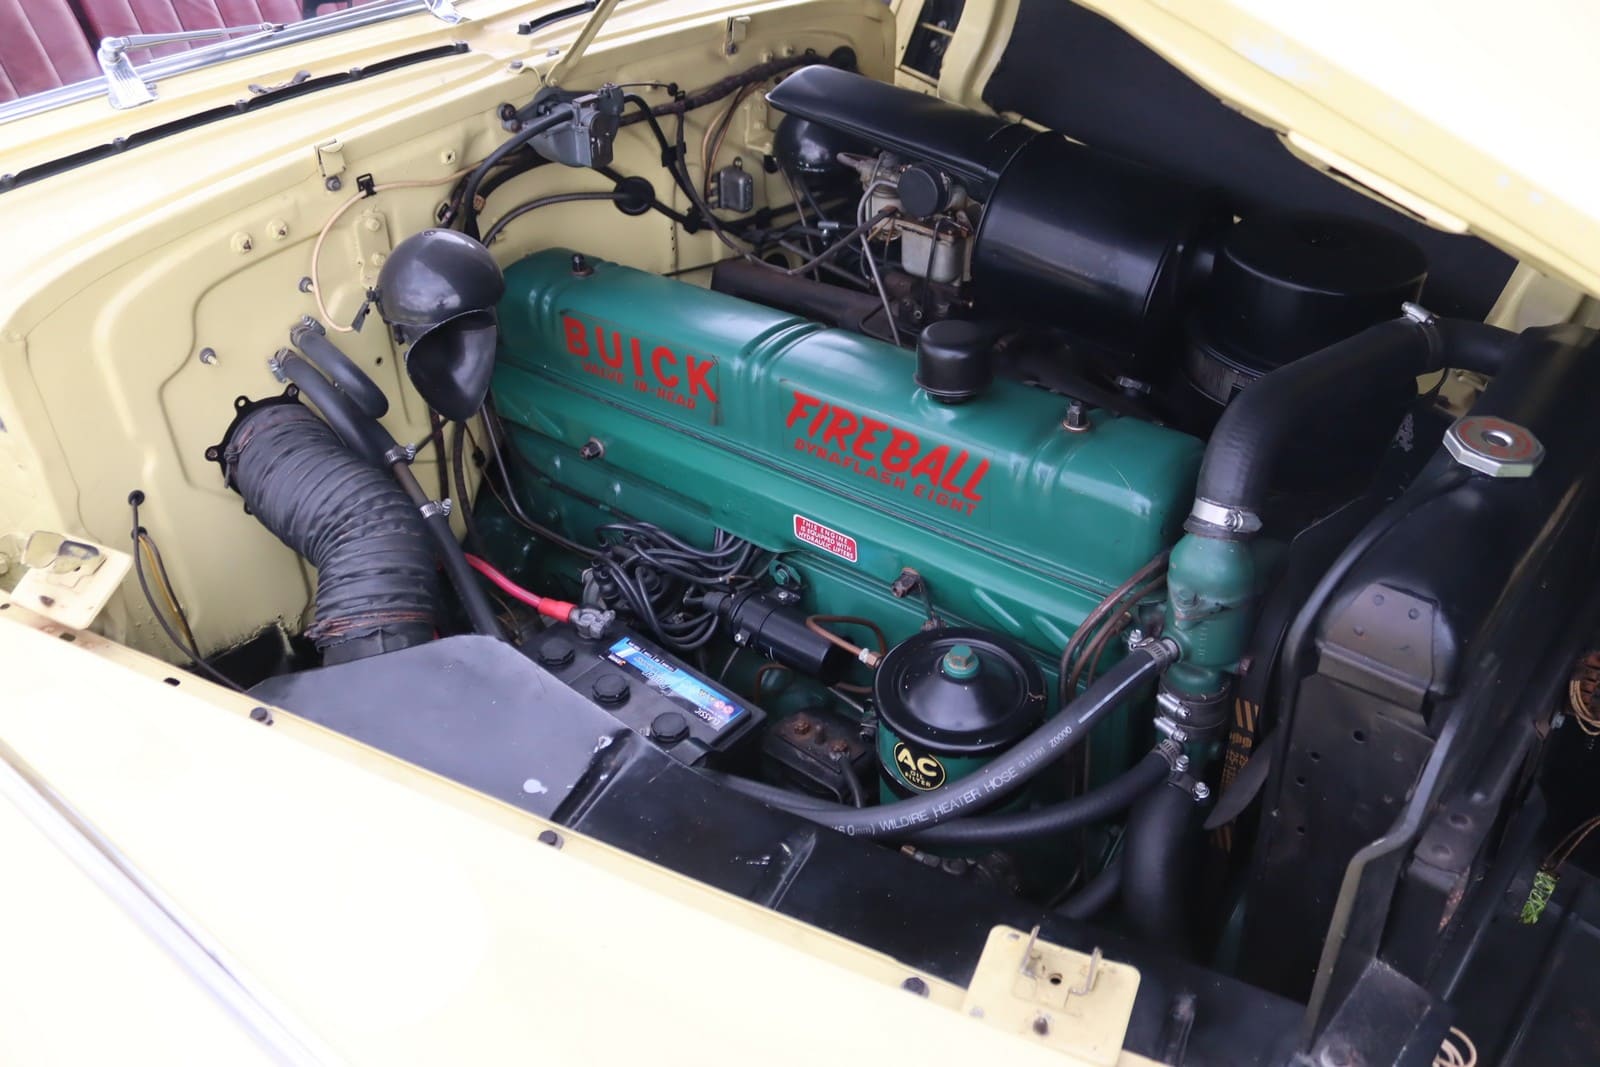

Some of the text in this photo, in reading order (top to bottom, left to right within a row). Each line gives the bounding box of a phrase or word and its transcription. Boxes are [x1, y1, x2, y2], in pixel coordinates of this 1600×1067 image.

[563, 316, 718, 403] BUICK
[582, 361, 696, 409] VALVE IN-HEAD
[785, 389, 990, 501] FIREBALL
[794, 437, 977, 516] DYNAFLASH EIGHT
[799, 532, 854, 559] HYDRAULIC LIFTERS
[802, 520, 848, 544] THIS ENGINE
[807, 528, 835, 545] EQUIPPED
[836, 540, 852, 552] WITH
[694, 707, 722, 726] CLASSIC
[898, 748, 937, 776] AC
[910, 770, 924, 780] OIL
[904, 771, 931, 787] FILTER
[934, 787, 982, 818] HEATER
[984, 766, 1018, 793] HOSE
